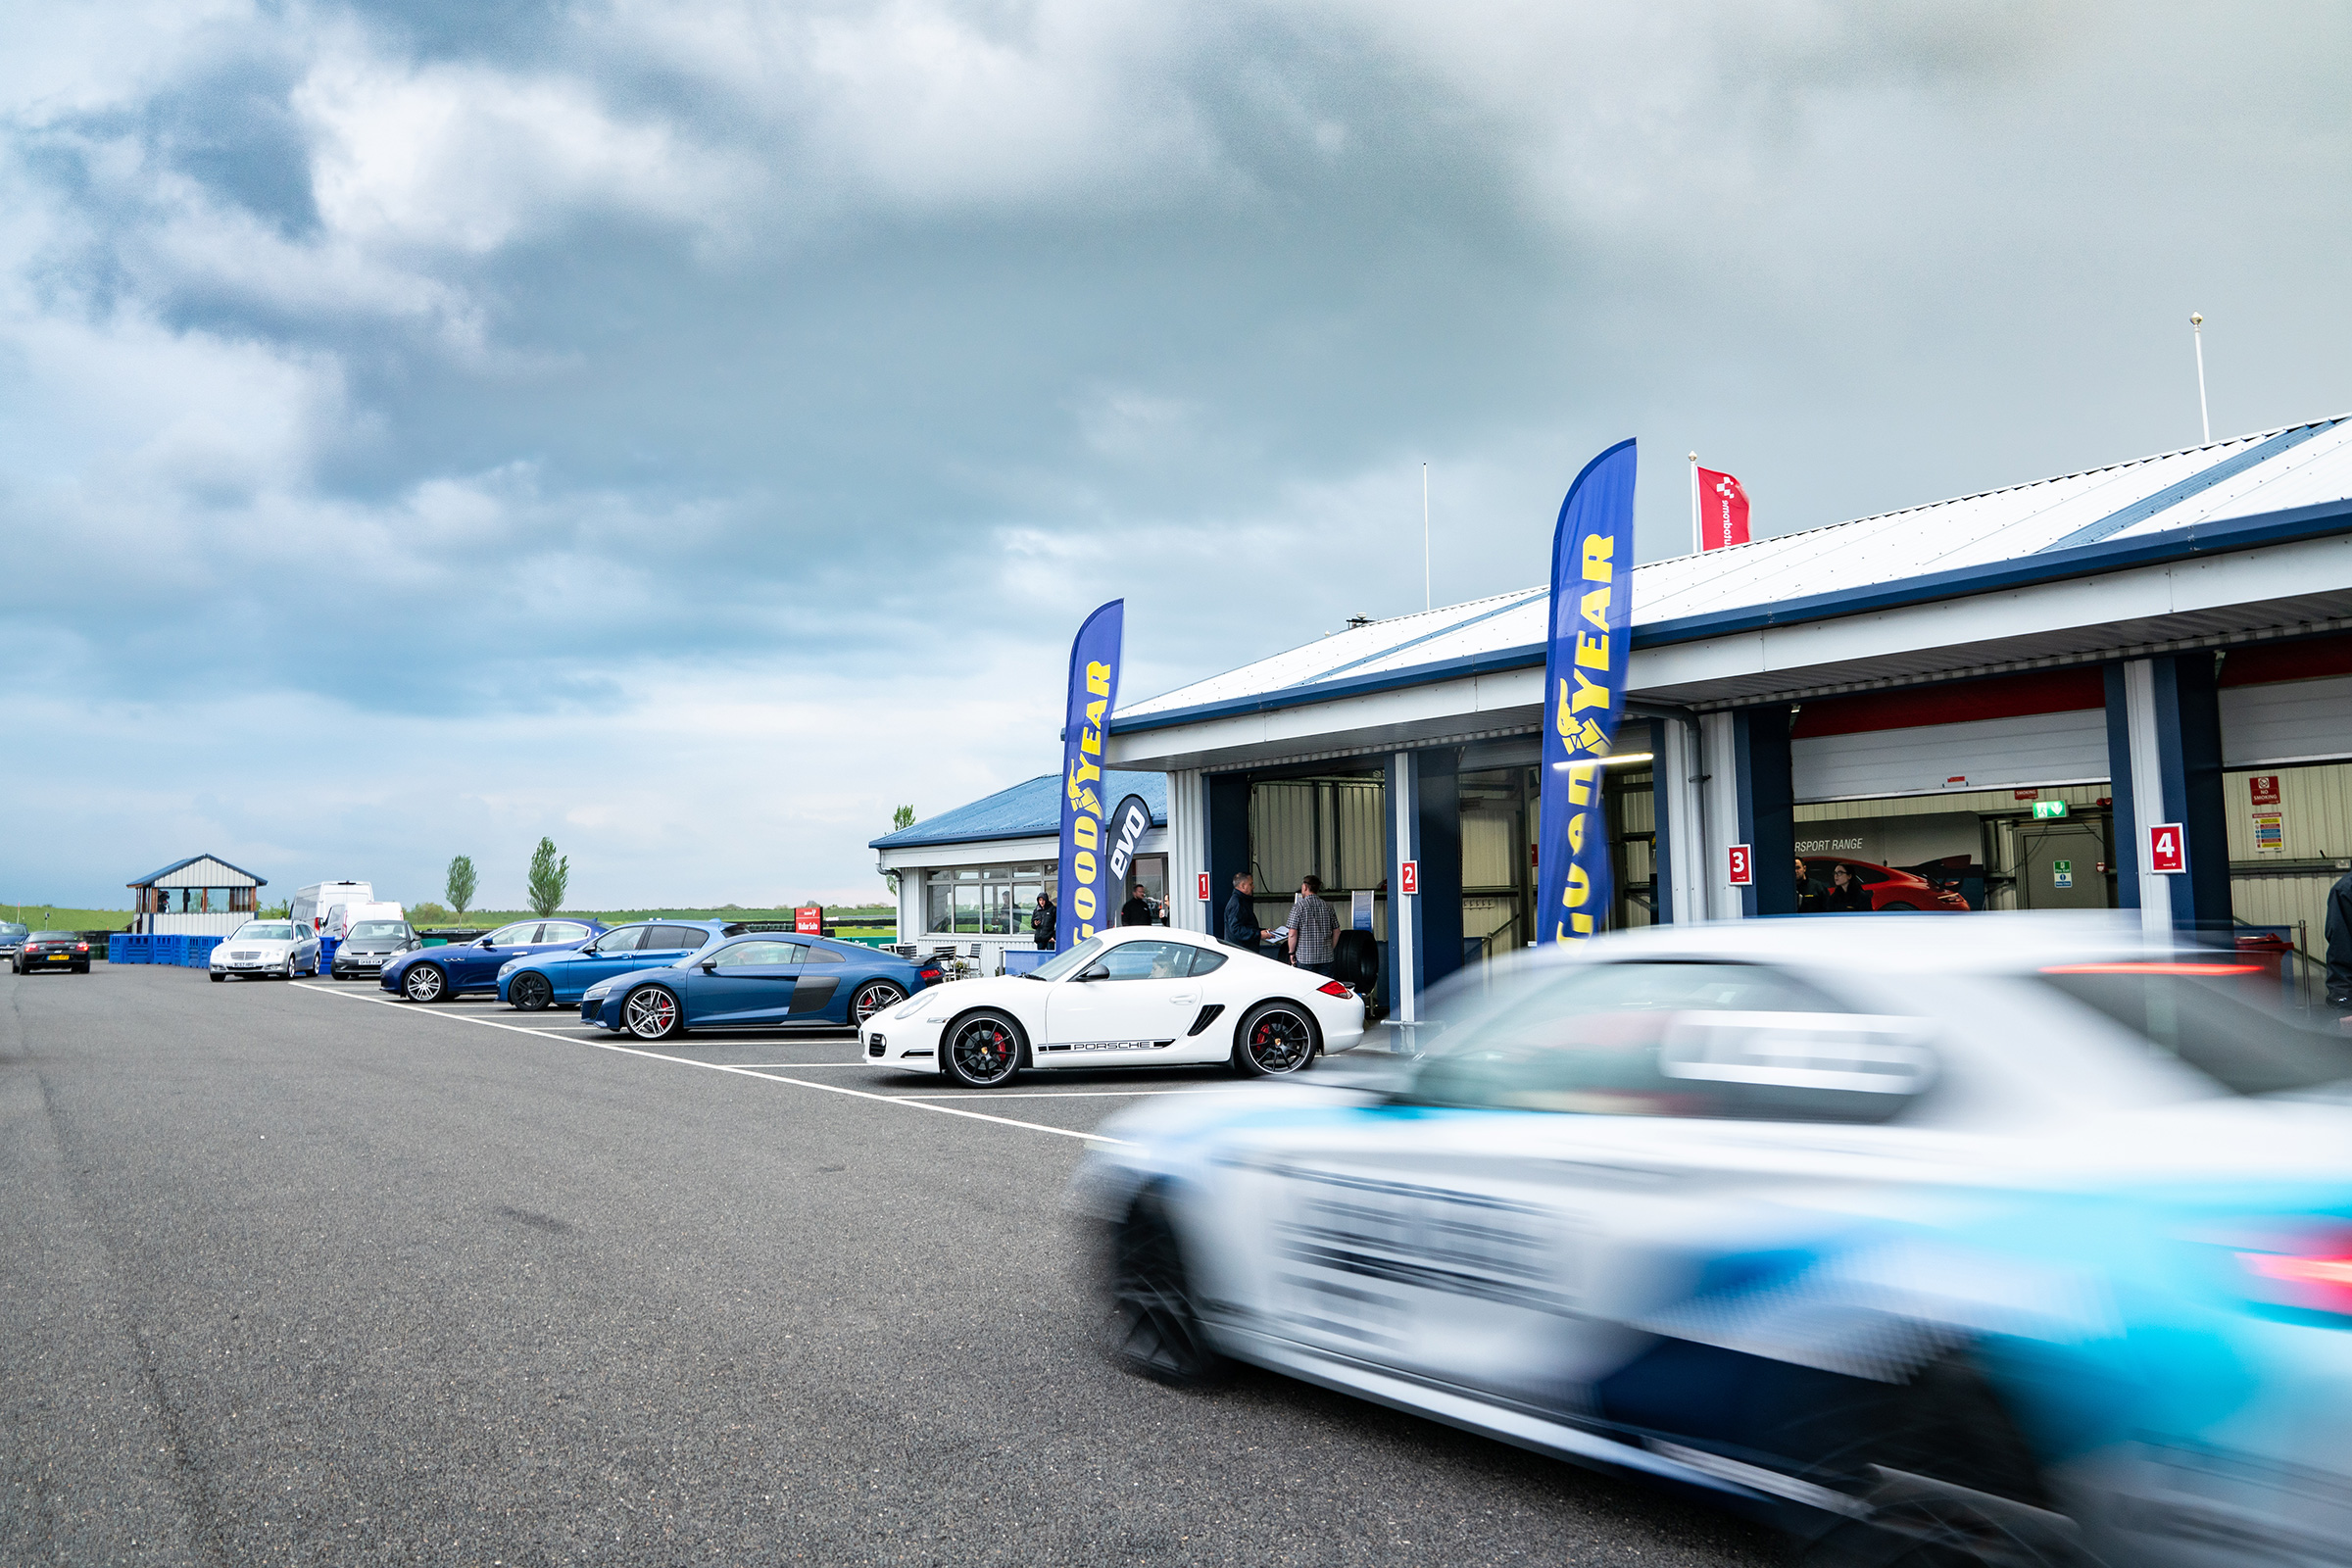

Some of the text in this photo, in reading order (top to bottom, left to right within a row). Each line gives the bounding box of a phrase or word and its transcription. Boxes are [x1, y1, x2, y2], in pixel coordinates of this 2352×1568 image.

[1109, 805, 1145, 881] evo
[1832, 838, 1864, 851] RANGE
[2156, 832, 2176, 858] 4
[1733, 851, 1744, 873] 3
[1200, 876, 1206, 892] 1
[1404, 866, 1414, 884] 2
[1073, 1041, 1151, 1051] PORSCHE
